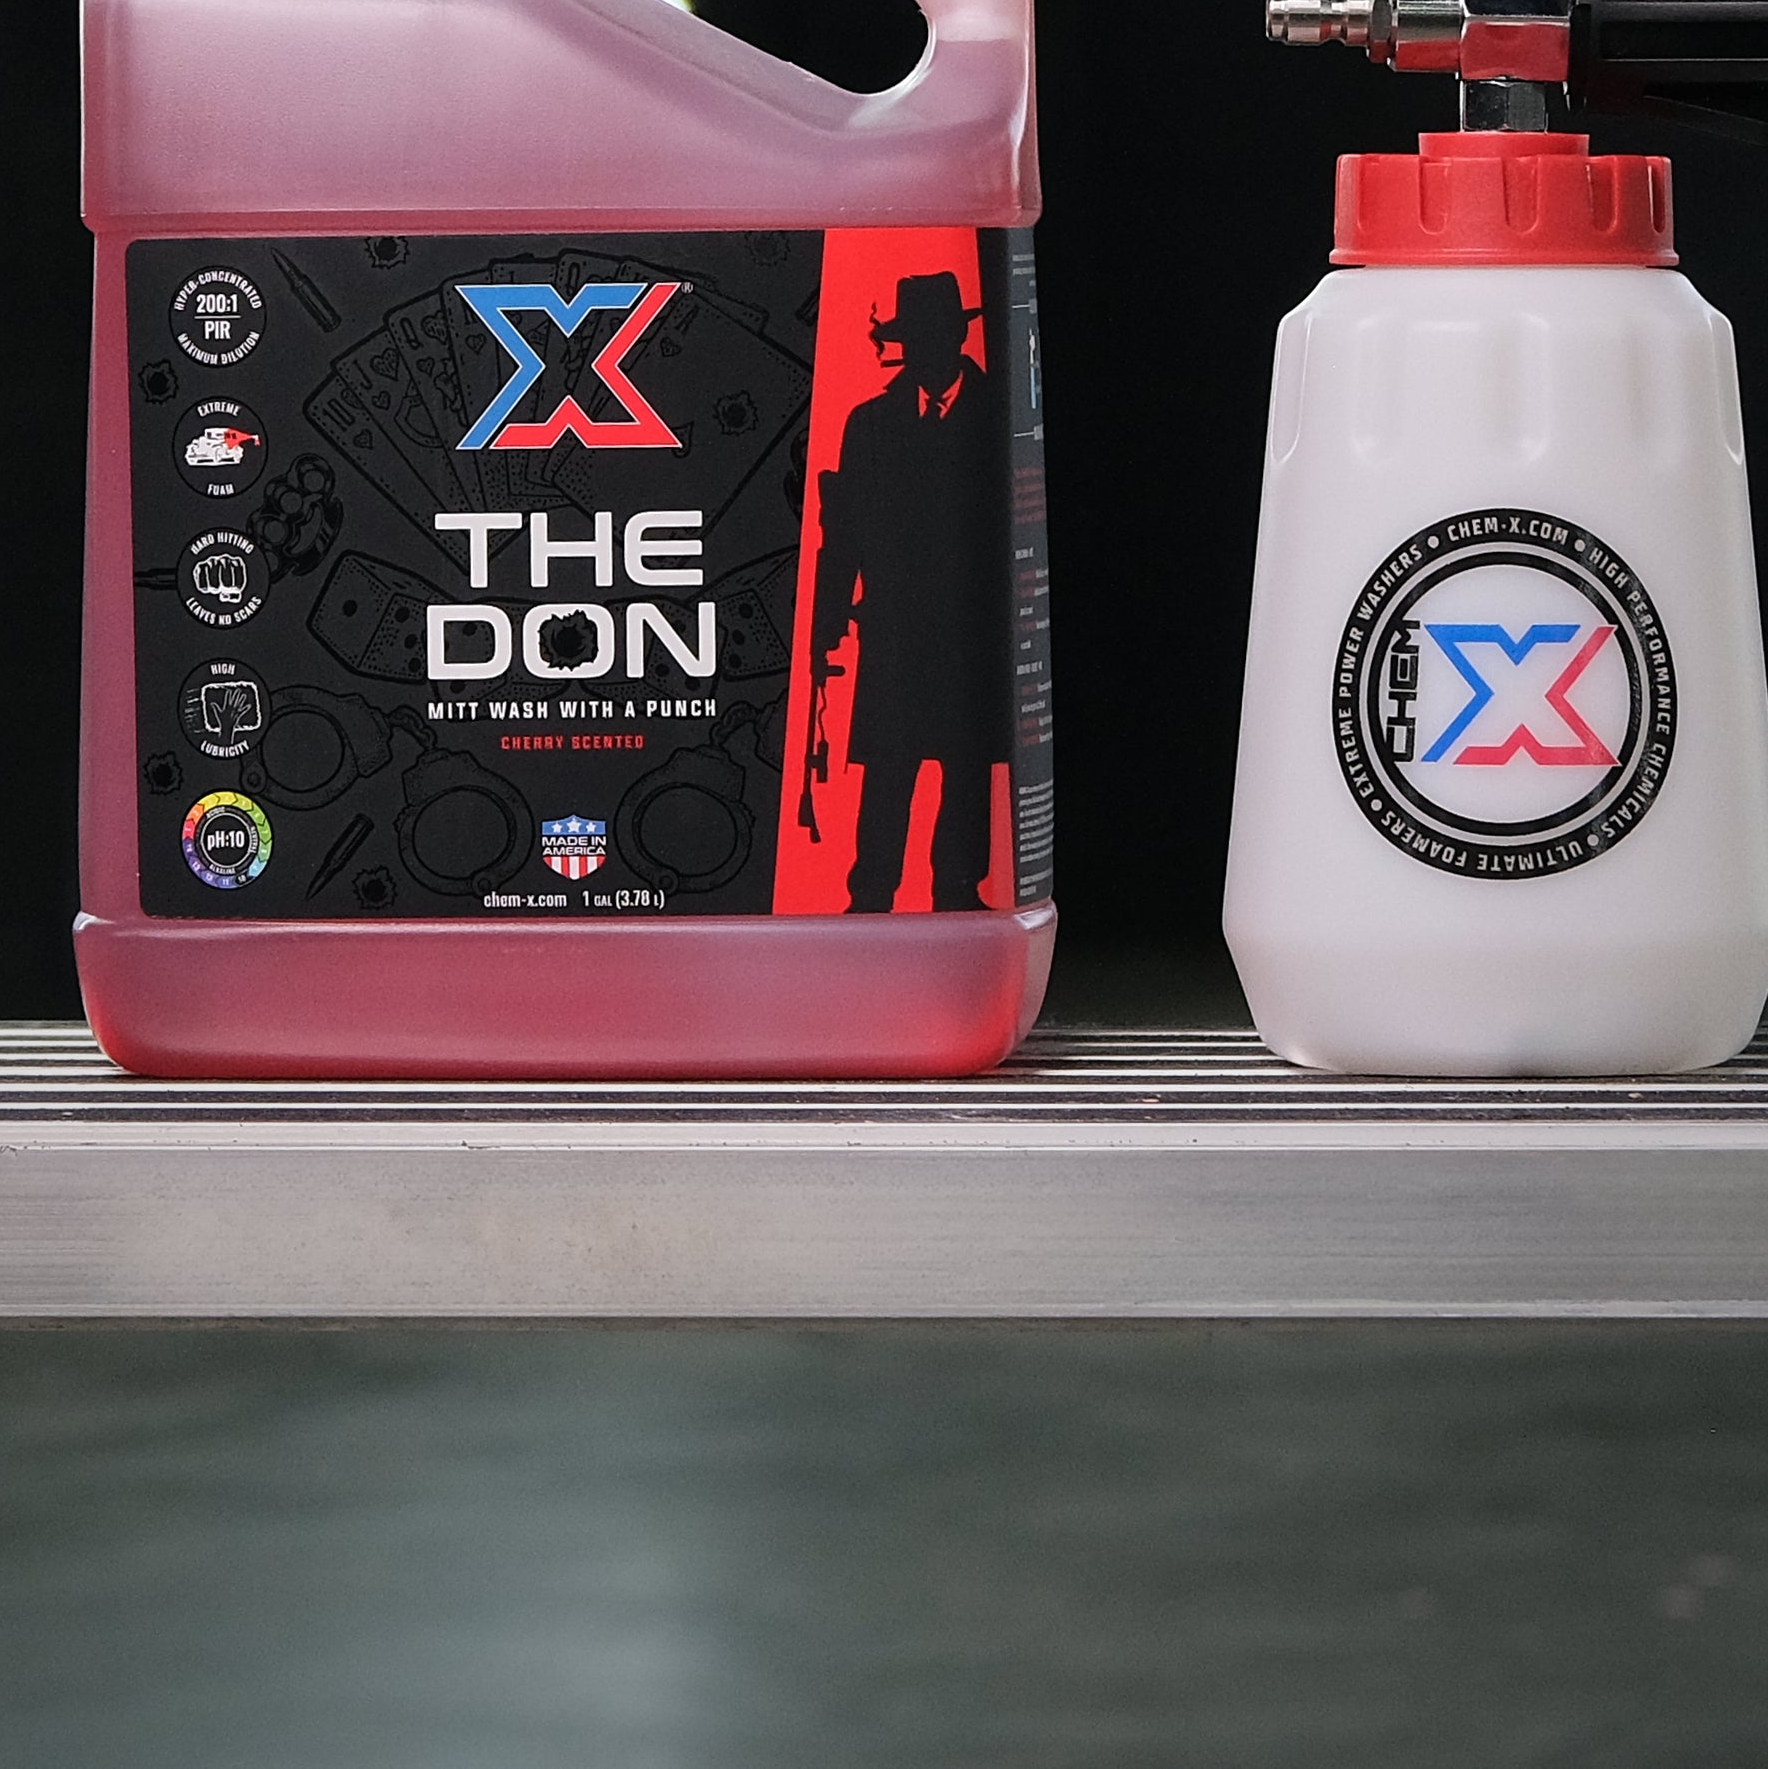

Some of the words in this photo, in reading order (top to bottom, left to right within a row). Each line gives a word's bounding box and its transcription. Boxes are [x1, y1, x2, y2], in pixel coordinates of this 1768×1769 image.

[173, 270, 263, 311] HYPER-CONCENTRATED
[196, 293, 238, 313] 200:1
[204, 320, 231, 340] PIR
[177, 333, 218, 365] MAXIMUM
[221, 331, 260, 365] DILUTION
[197, 401, 241, 417] EXTREME
[207, 483, 235, 497] FOAM
[191, 534, 215, 555] HARD
[217, 532, 255, 554] HITTING
[1447, 516, 1569, 545] CHEM-X.COM
[434, 510, 704, 589] THE
[1357, 544, 1422, 621] WASHERS
[1589, 547, 1630, 589] HIGH
[186, 597, 216, 625] LEAVES
[218, 614, 232, 625] NO
[234, 596, 262, 623] SCARS
[426, 601, 717, 680] DON
[210, 663, 236, 675] HIGH
[1338, 627, 1364, 699] POWER
[1627, 590, 1671, 735] PERFORMANCE
[1386, 620, 1421, 763] CHEM
[428, 701, 479, 721] MITT
[489, 700, 549, 720] WASH
[559, 700, 614, 719] WITH
[624, 700, 635, 718] A
[646, 698, 717, 718] PUNCH
[200, 739, 250, 758] LUBRICITY
[500, 735, 564, 751] CHERRY
[571, 734, 645, 750] SCENTED
[1338, 706, 1375, 798] EXTREME
[1600, 743, 1667, 838] CHEMICALS
[207, 830, 245, 851] pH:10
[541, 836, 588, 846] MADE
[591, 836, 607, 846] IN
[542, 846, 606, 856] AMERICA
[1381, 811, 1468, 867] FOAMERS
[1477, 840, 1583, 872] ULTIMATE
[483, 890, 568, 908] chem-x.com
[582, 890, 590, 907] 1
[594, 895, 612, 907] GAL
[615, 889, 651, 910] (3.78
